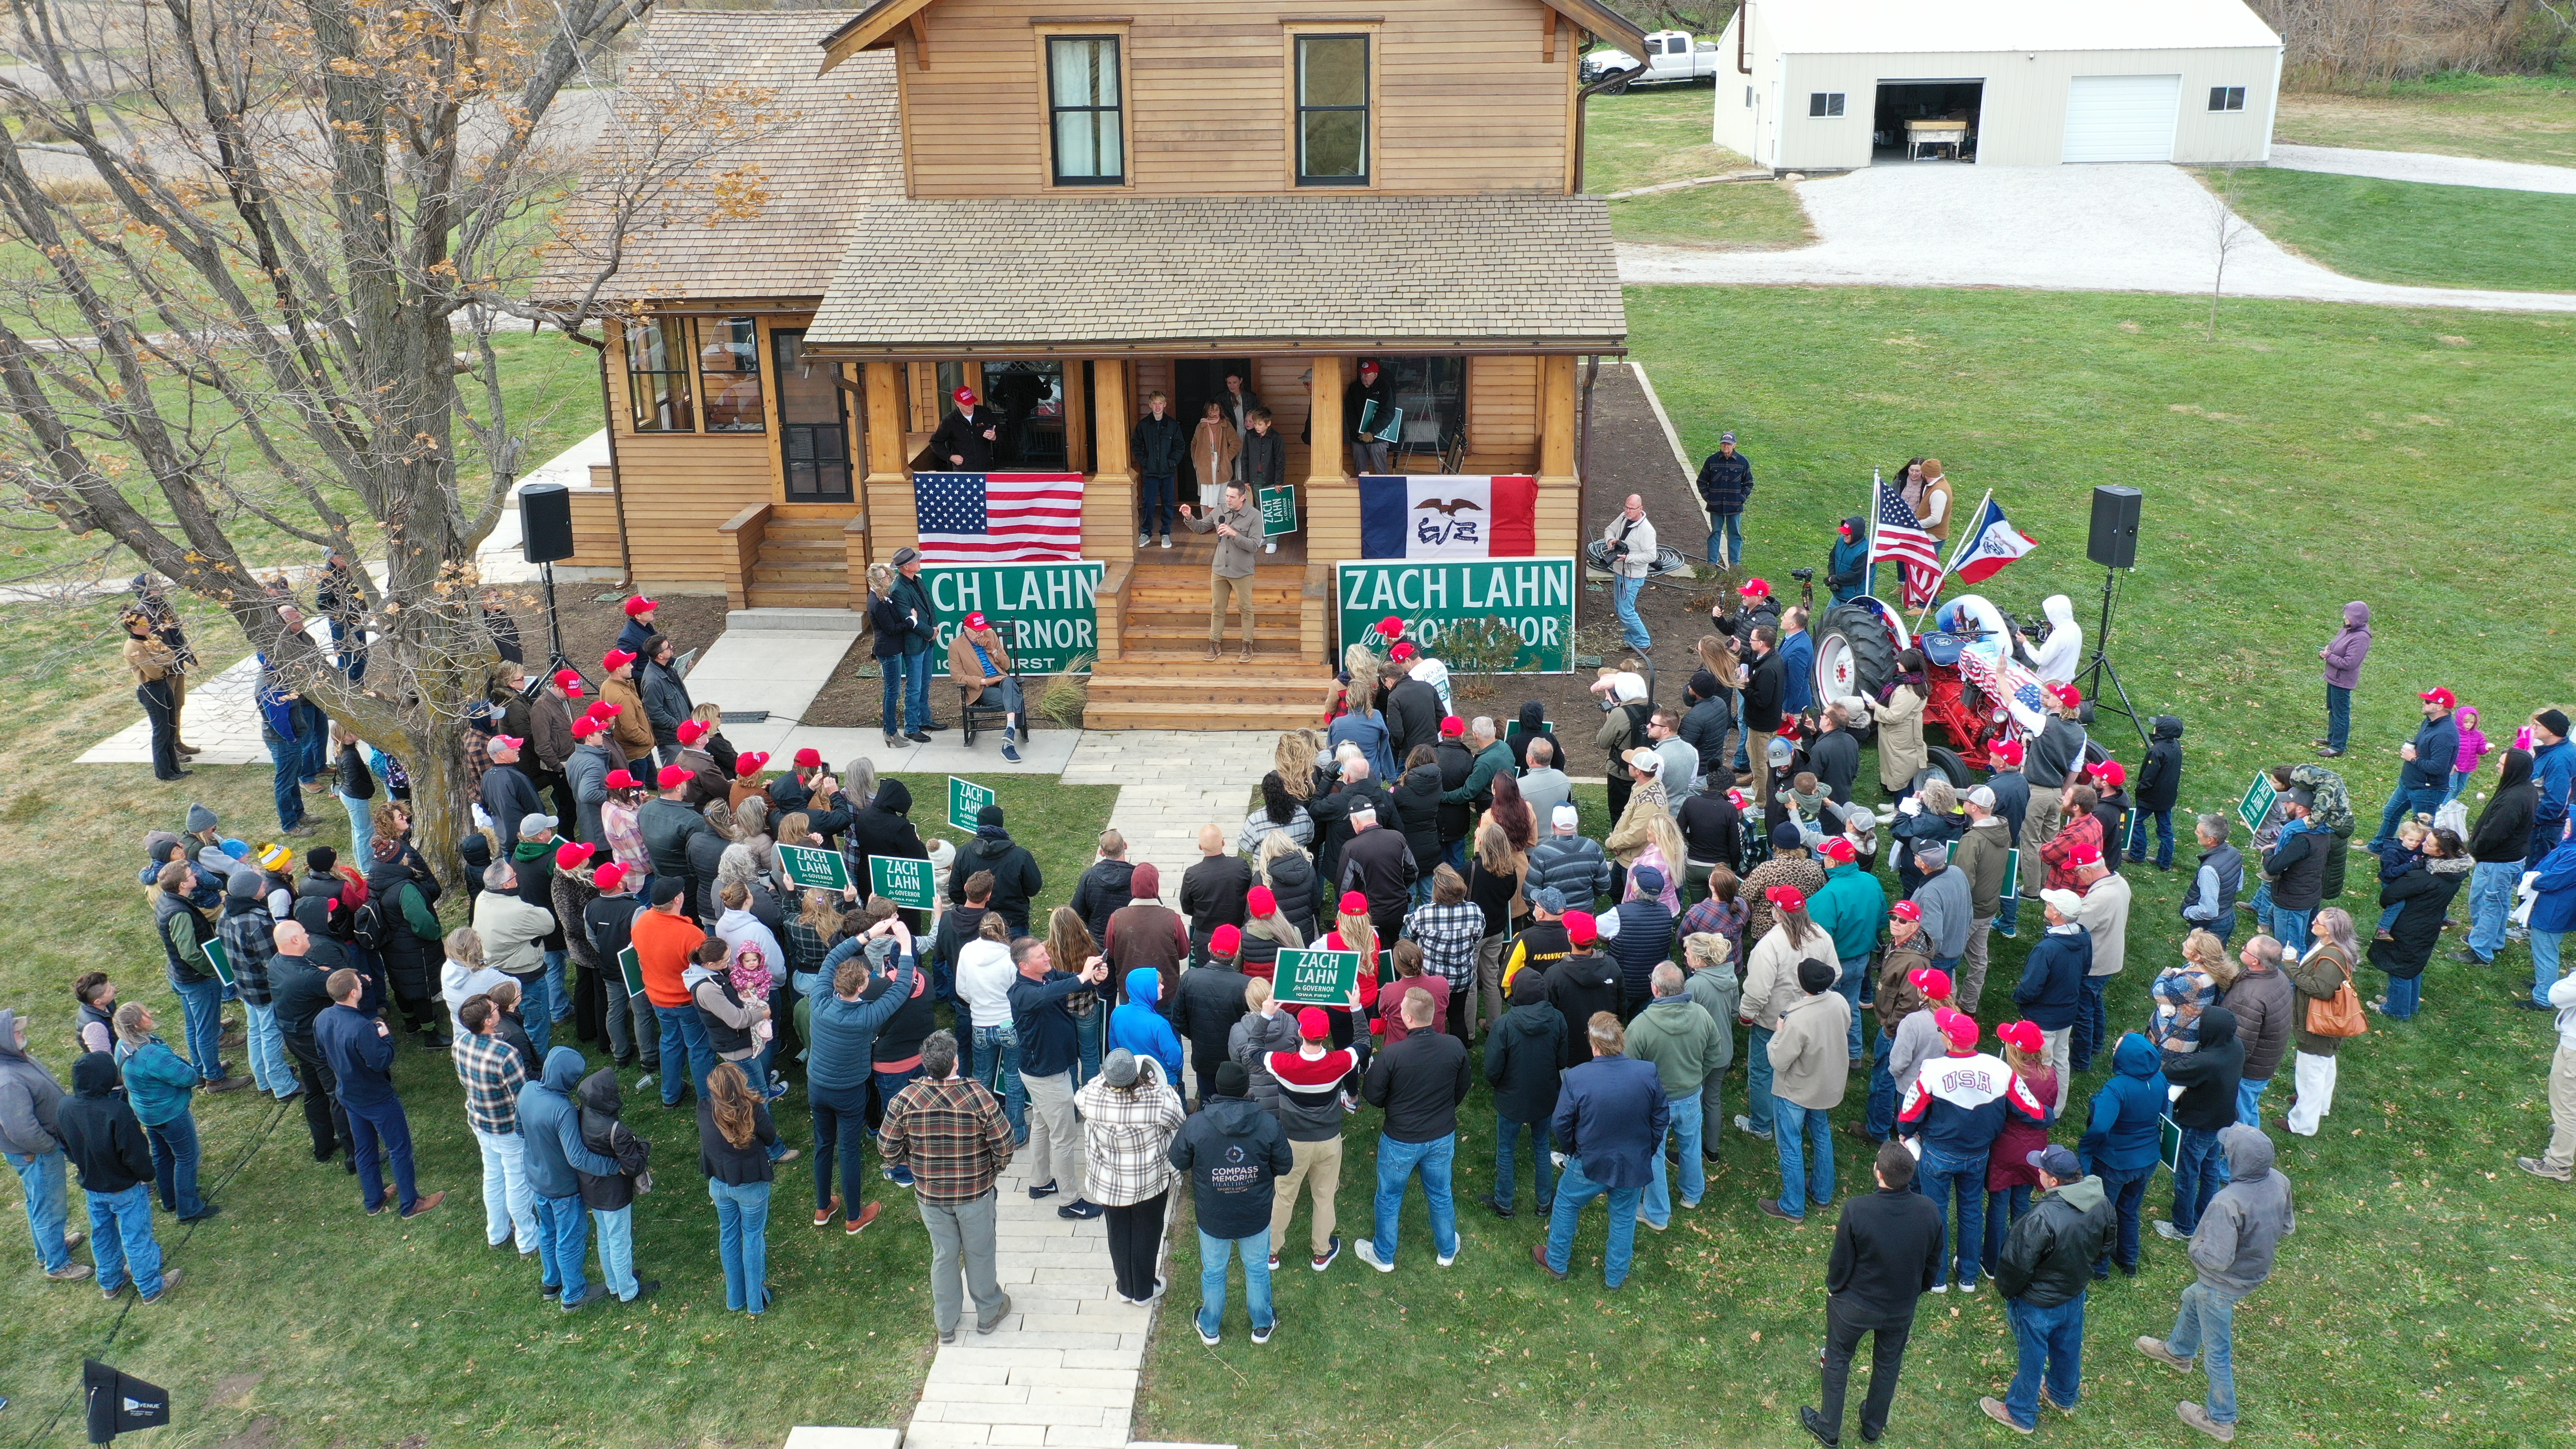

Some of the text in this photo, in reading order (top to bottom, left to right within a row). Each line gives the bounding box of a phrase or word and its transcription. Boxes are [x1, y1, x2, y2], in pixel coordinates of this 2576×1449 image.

[1263, 500, 1273, 524] ZACH
[1272, 498, 1283, 523] LAHN
[932, 569, 1098, 612] CH LAHN
[1345, 565, 1568, 610] ZACH LAHN
[1012, 658, 1055, 669] IRST
[960, 782, 982, 803] ZACH
[2257, 779, 2271, 800] ZACH
[959, 797, 983, 815] LAHN
[2251, 790, 2265, 813] LAHN
[794, 848, 828, 863] ZACH
[797, 860, 832, 875] LAHN
[886, 860, 918, 876] ZACH
[808, 873, 834, 881] GOVERNOR
[886, 874, 920, 890] LAHN
[894, 890, 920, 898] GOVERNOR
[1297, 952, 1340, 969] ZACH
[1295, 968, 1338, 984] LAHN
[1942, 1070, 1991, 1094] USA
[1212, 1166, 1258, 1175] COMPASS
[1212, 1173, 1258, 1182] MEMORIAL
[1213, 1178, 1258, 1187] HEALTHCARE
